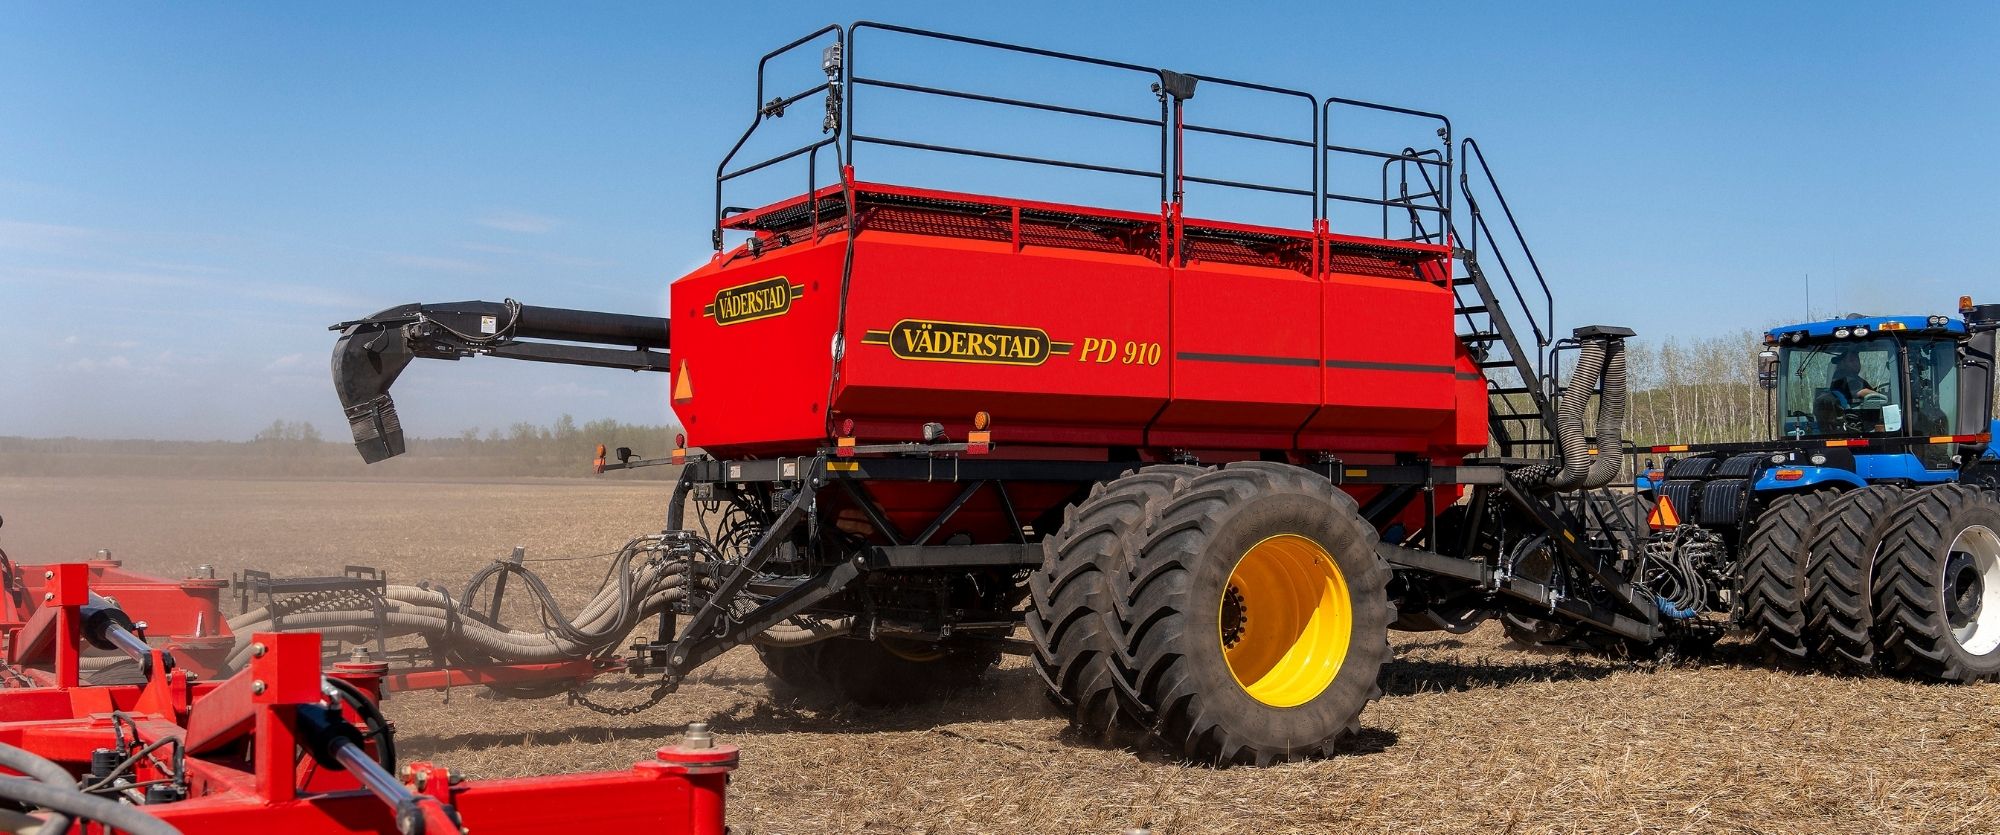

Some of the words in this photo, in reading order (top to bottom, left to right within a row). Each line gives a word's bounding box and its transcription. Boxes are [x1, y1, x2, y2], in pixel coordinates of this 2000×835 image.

[719, 290, 786, 319] VÄDERSTAD
[903, 324, 1040, 358] VÄDERSTAD
[1079, 337, 1117, 363] PD
[1122, 341, 1160, 365] 910
